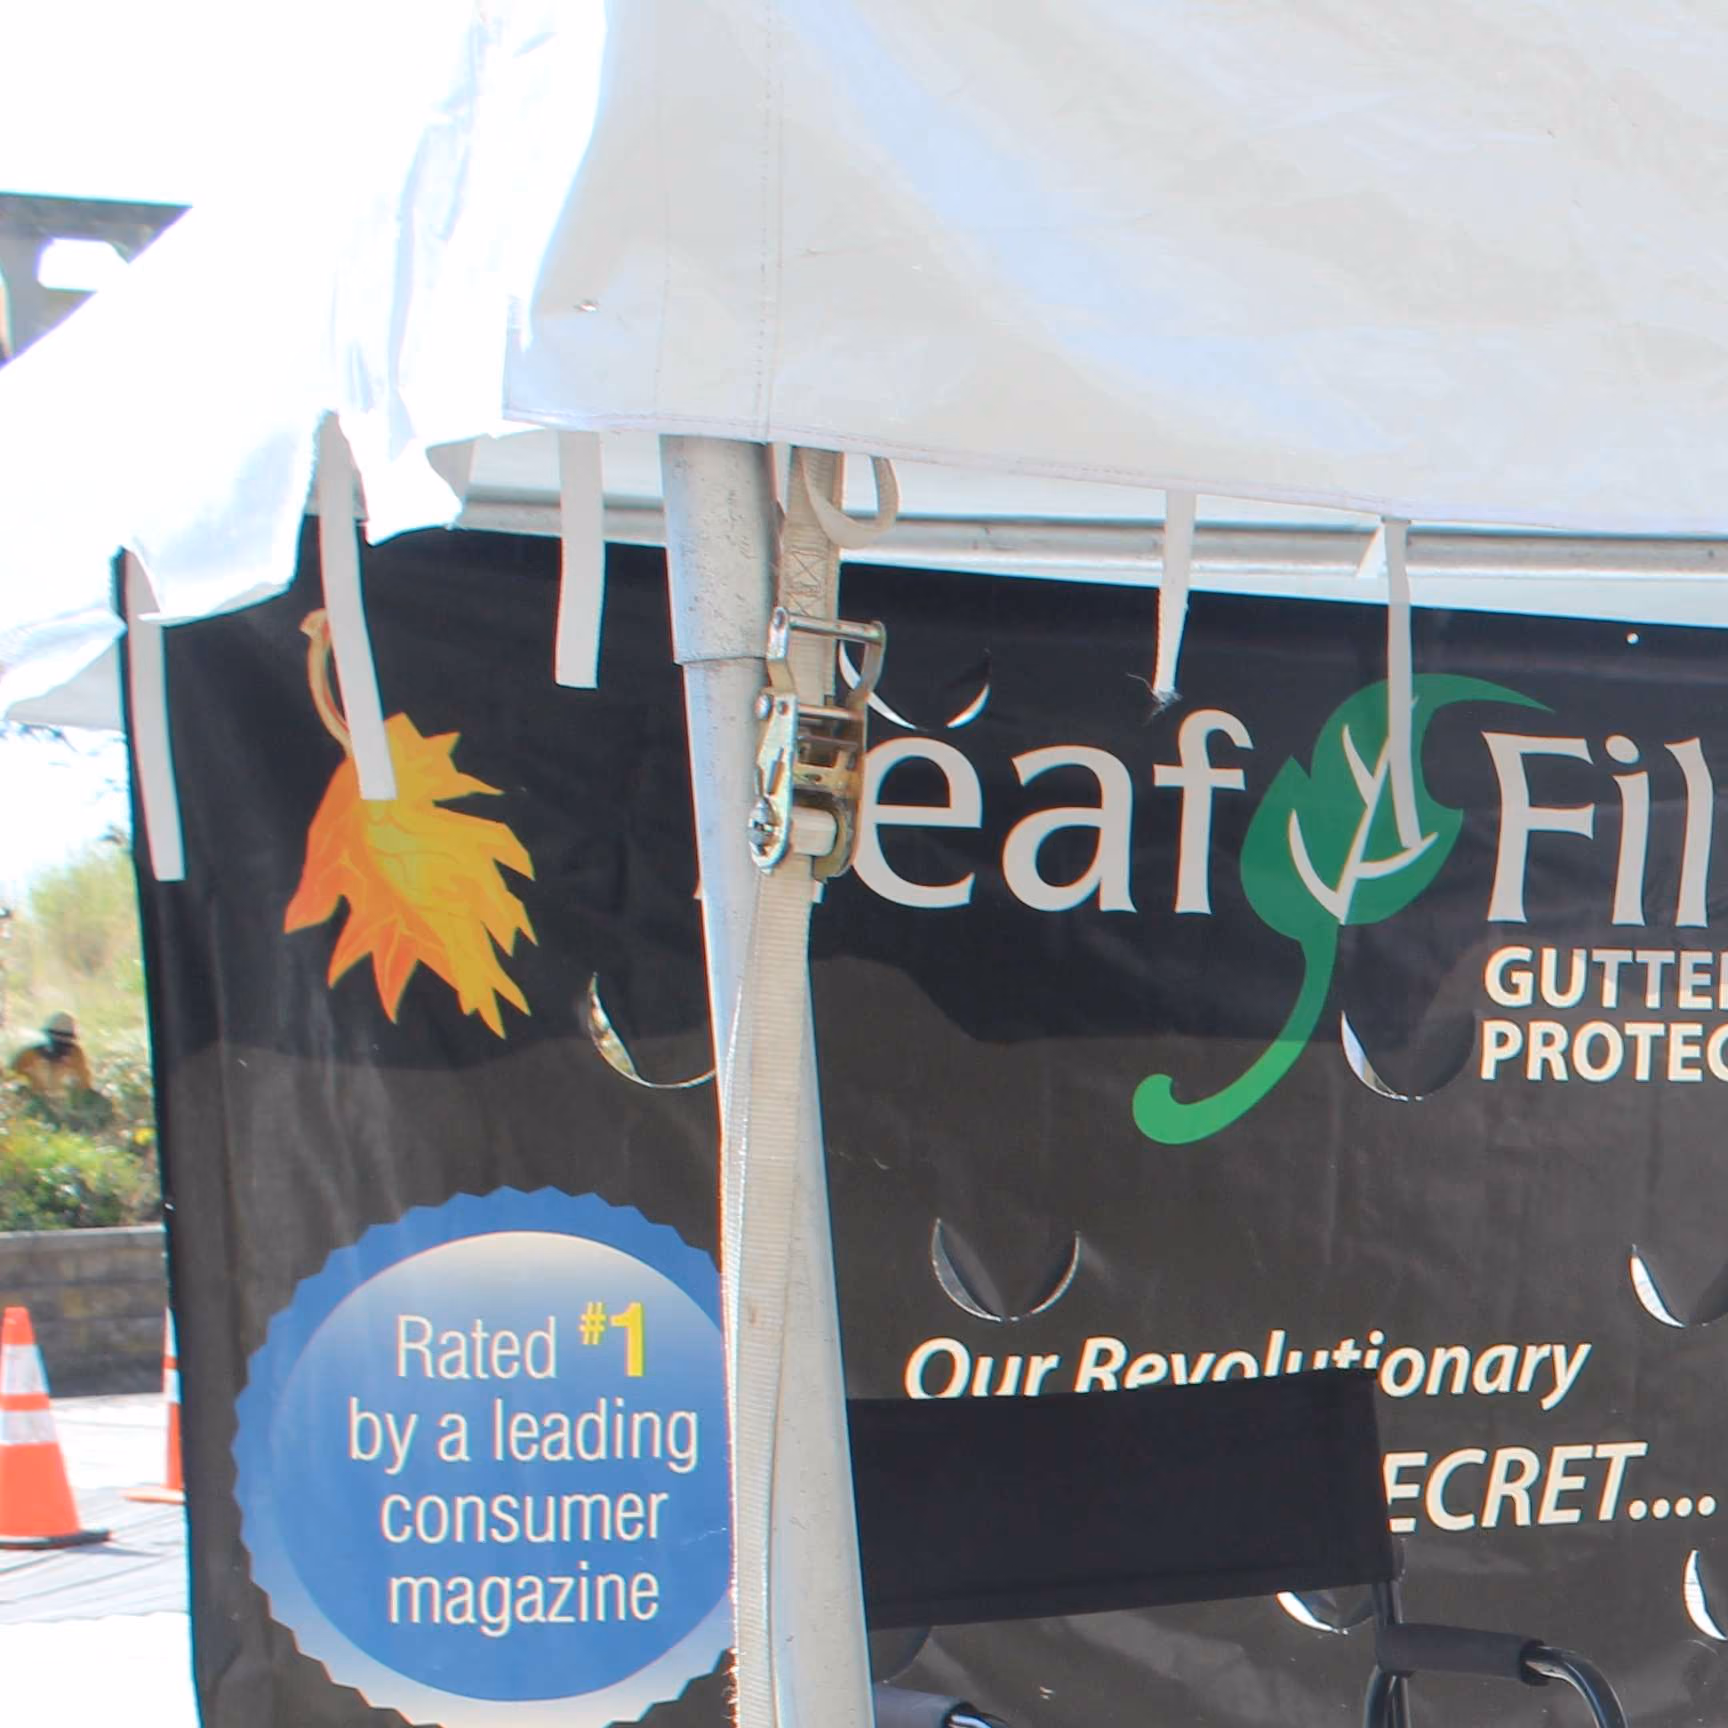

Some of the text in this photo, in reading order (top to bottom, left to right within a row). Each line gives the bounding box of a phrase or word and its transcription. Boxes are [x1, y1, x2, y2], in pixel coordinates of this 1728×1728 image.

[693, 708, 1253, 914] eaf
[396, 1301, 646, 1380] Rated #1
[905, 1337, 1060, 1400] Our
[350, 1396, 699, 1476] by a leading
[380, 1490, 670, 1544] consumer
[1383, 1443, 1717, 1534] ECRET....
[388, 1560, 661, 1637] magazine
